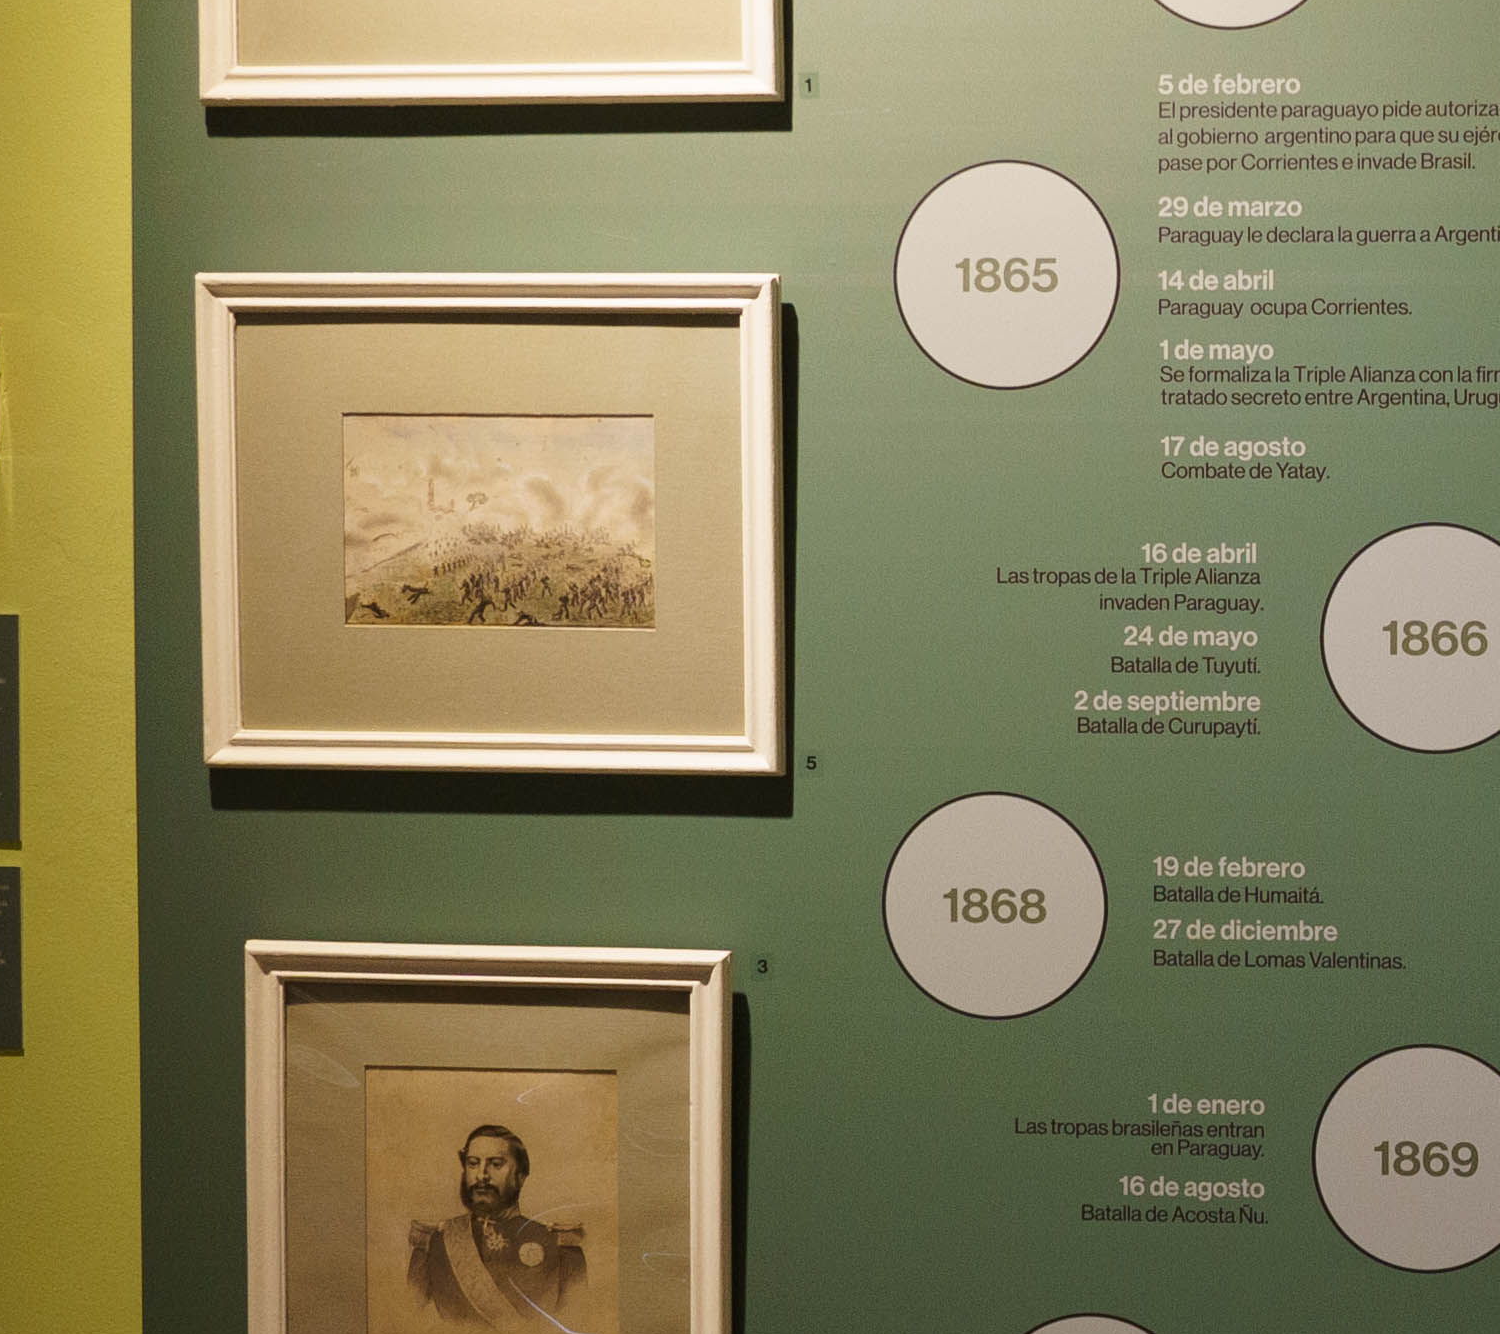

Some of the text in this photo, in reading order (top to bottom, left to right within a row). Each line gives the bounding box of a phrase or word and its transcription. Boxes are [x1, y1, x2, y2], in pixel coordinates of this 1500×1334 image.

[805, 78, 812, 92] 1
[1157, 72, 1301, 96] 5 de febrero
[1158, 101, 1176, 119] El
[1179, 100, 1278, 123] presidente
[1280, 103, 1380, 122] paraguayo
[1382, 99, 1423, 121] pide
[1157, 151, 1477, 175] pase por Corrientes e invade Brasil.
[1158, 195, 1303, 218] 29 de marzo
[1158, 225, 1244, 248] Paraguay
[1247, 225, 1264, 244] le
[1265, 225, 1335, 244] declara
[1337, 225, 1354, 243] la
[1355, 229, 1417, 247] guerra
[1419, 229, 1432, 243] a
[954, 256, 1059, 294] 1865
[1157, 268, 1275, 292] 14 de abril
[1157, 297, 1413, 320] Paraguay ocupa Corrientes.
[1159, 338, 1275, 365] 1 de mayo
[1160, 434, 1307, 462] 17 de agosto
[1160, 460, 1331, 484] Combate de Yatay.
[1140, 541, 1257, 564] 16 de abril
[996, 566, 1262, 589] Las tropas de la Triple Alianza
[1099, 593, 1265, 615] invaden Paraguay.
[1123, 624, 1259, 652] 24 de mayo
[1381, 619, 1489, 658] 1866
[1110, 655, 1261, 678] Batalla de Tuyutí.
[1073, 689, 1262, 716] 2 de septiembre
[1076, 716, 1261, 739] Batalla de Curupaytí.
[806, 756, 818, 770] 5
[1152, 855, 1306, 879] 19 de febrero
[942, 887, 1048, 925] 1868
[1153, 884, 1325, 905] Batalla de Humaitá.
[1152, 918, 1339, 942] 27 de diciembre
[757, 959, 769, 974] 3
[1153, 948, 1407, 970] Batalla de Lomas Valentinas.
[1147, 1092, 1266, 1116] 1 de enero
[1014, 1116, 1265, 1139] Las tropas brasileñas entran
[1150, 1138, 1265, 1162] en Paraguay.
[1373, 1140, 1480, 1179] 1869
[1118, 1175, 1266, 1202] 16 de agosto
[1080, 1203, 1269, 1225] Batalla de Acosta Ñu.
